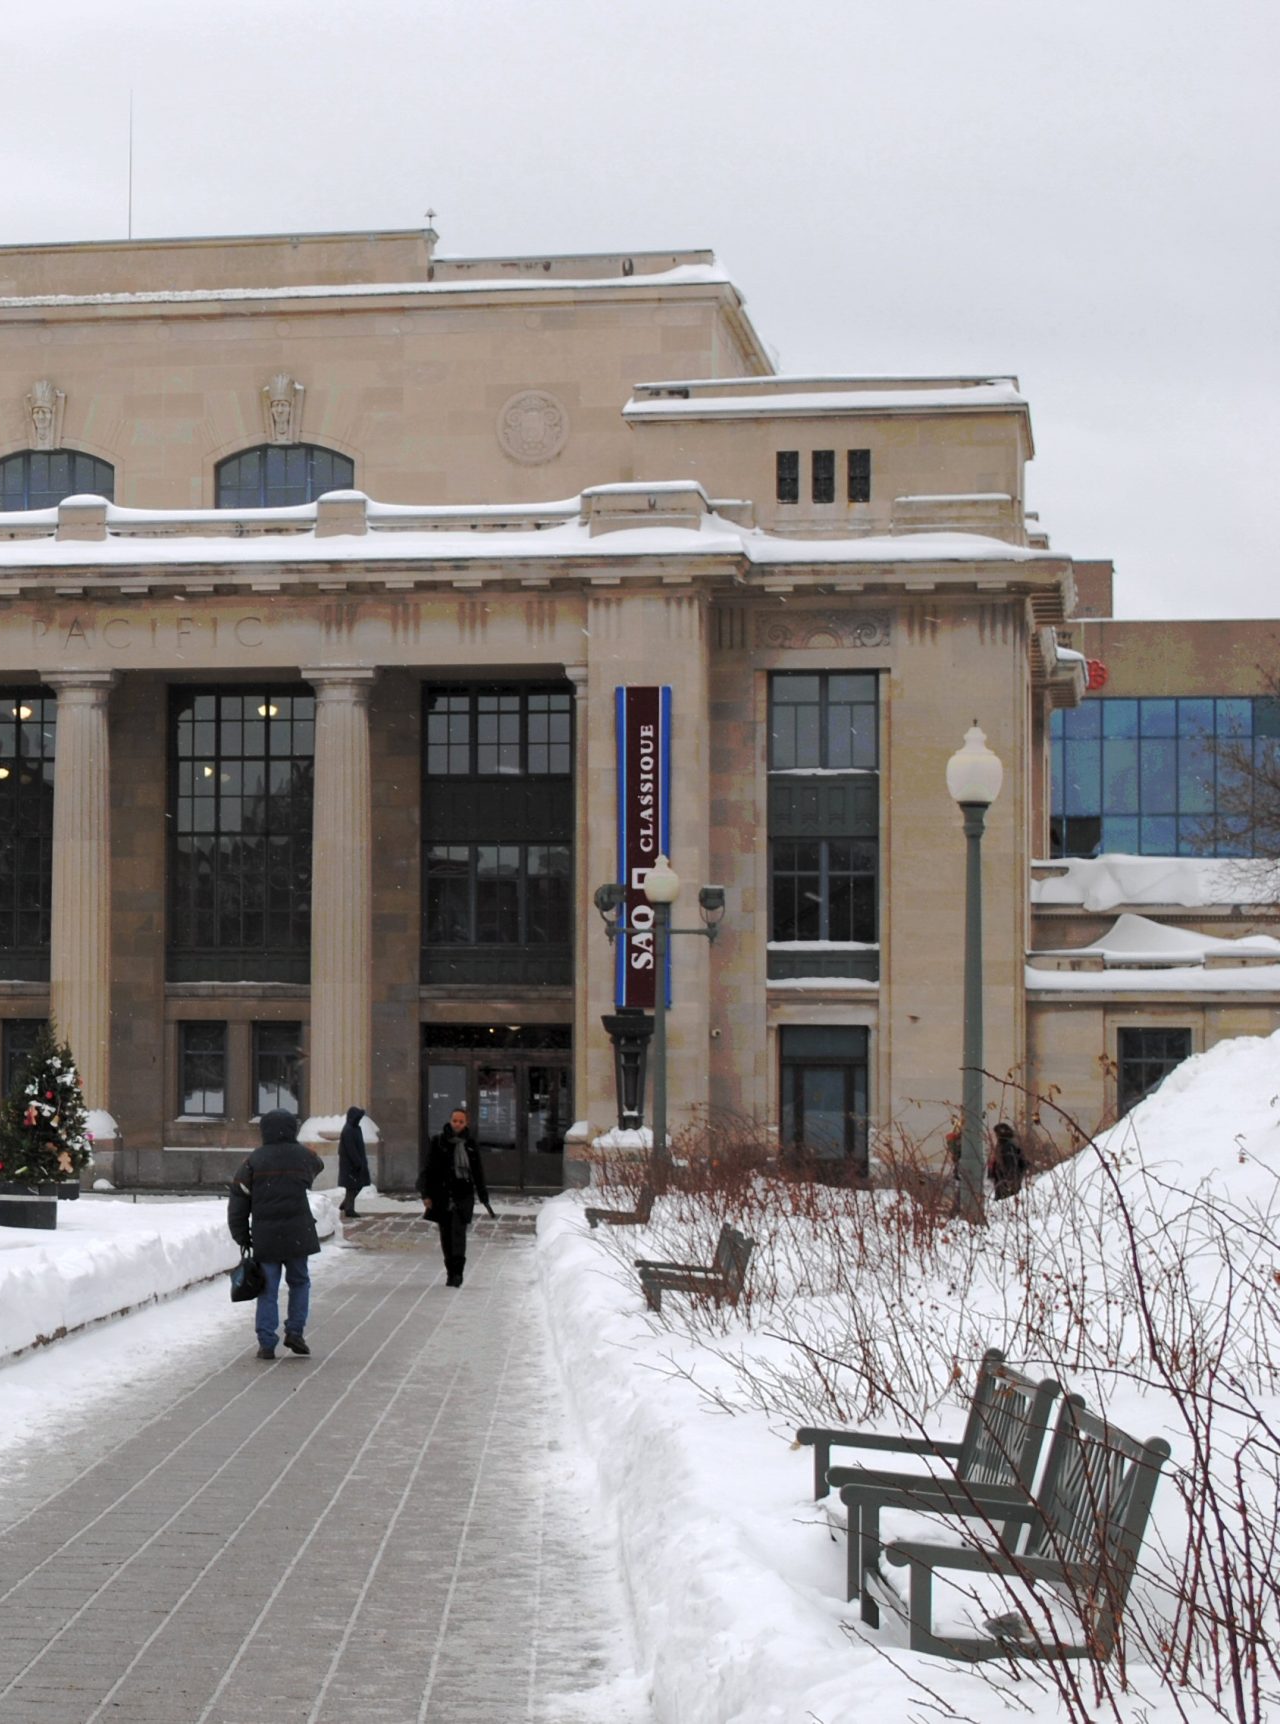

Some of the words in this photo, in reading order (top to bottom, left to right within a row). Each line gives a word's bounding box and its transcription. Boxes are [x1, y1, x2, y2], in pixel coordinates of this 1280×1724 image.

[31, 616, 264, 650] PACIFIC
[639, 724, 654, 852] CLASSIQUE
[631, 904, 654, 970] SAQ
